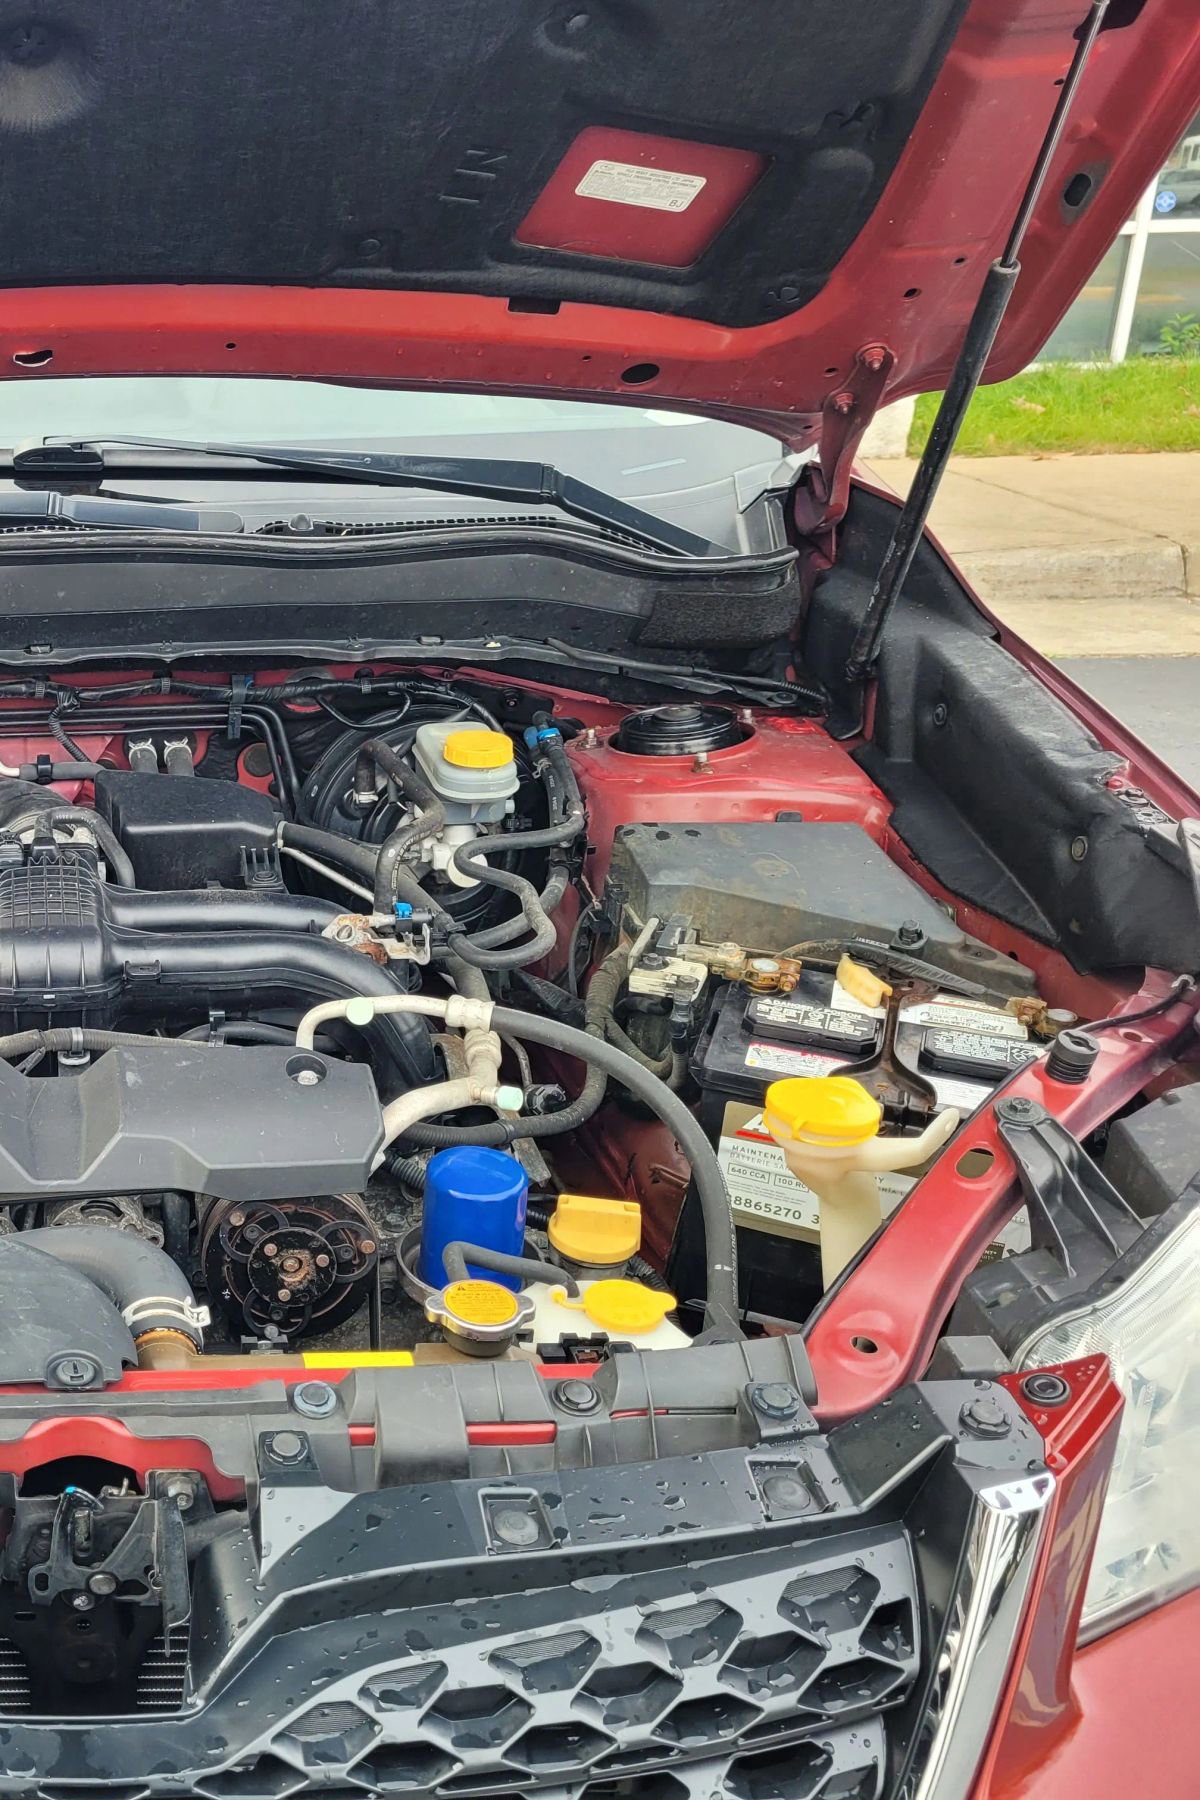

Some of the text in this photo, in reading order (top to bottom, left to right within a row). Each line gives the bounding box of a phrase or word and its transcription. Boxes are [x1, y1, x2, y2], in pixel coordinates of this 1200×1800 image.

[731, 1144, 784, 1162] MAINTENA
[731, 1166, 748, 1176] 640
[749, 1169, 766, 1181] CCA
[778, 1177, 793, 1187] 100
[730, 1194, 820, 1225] 8865270 3
